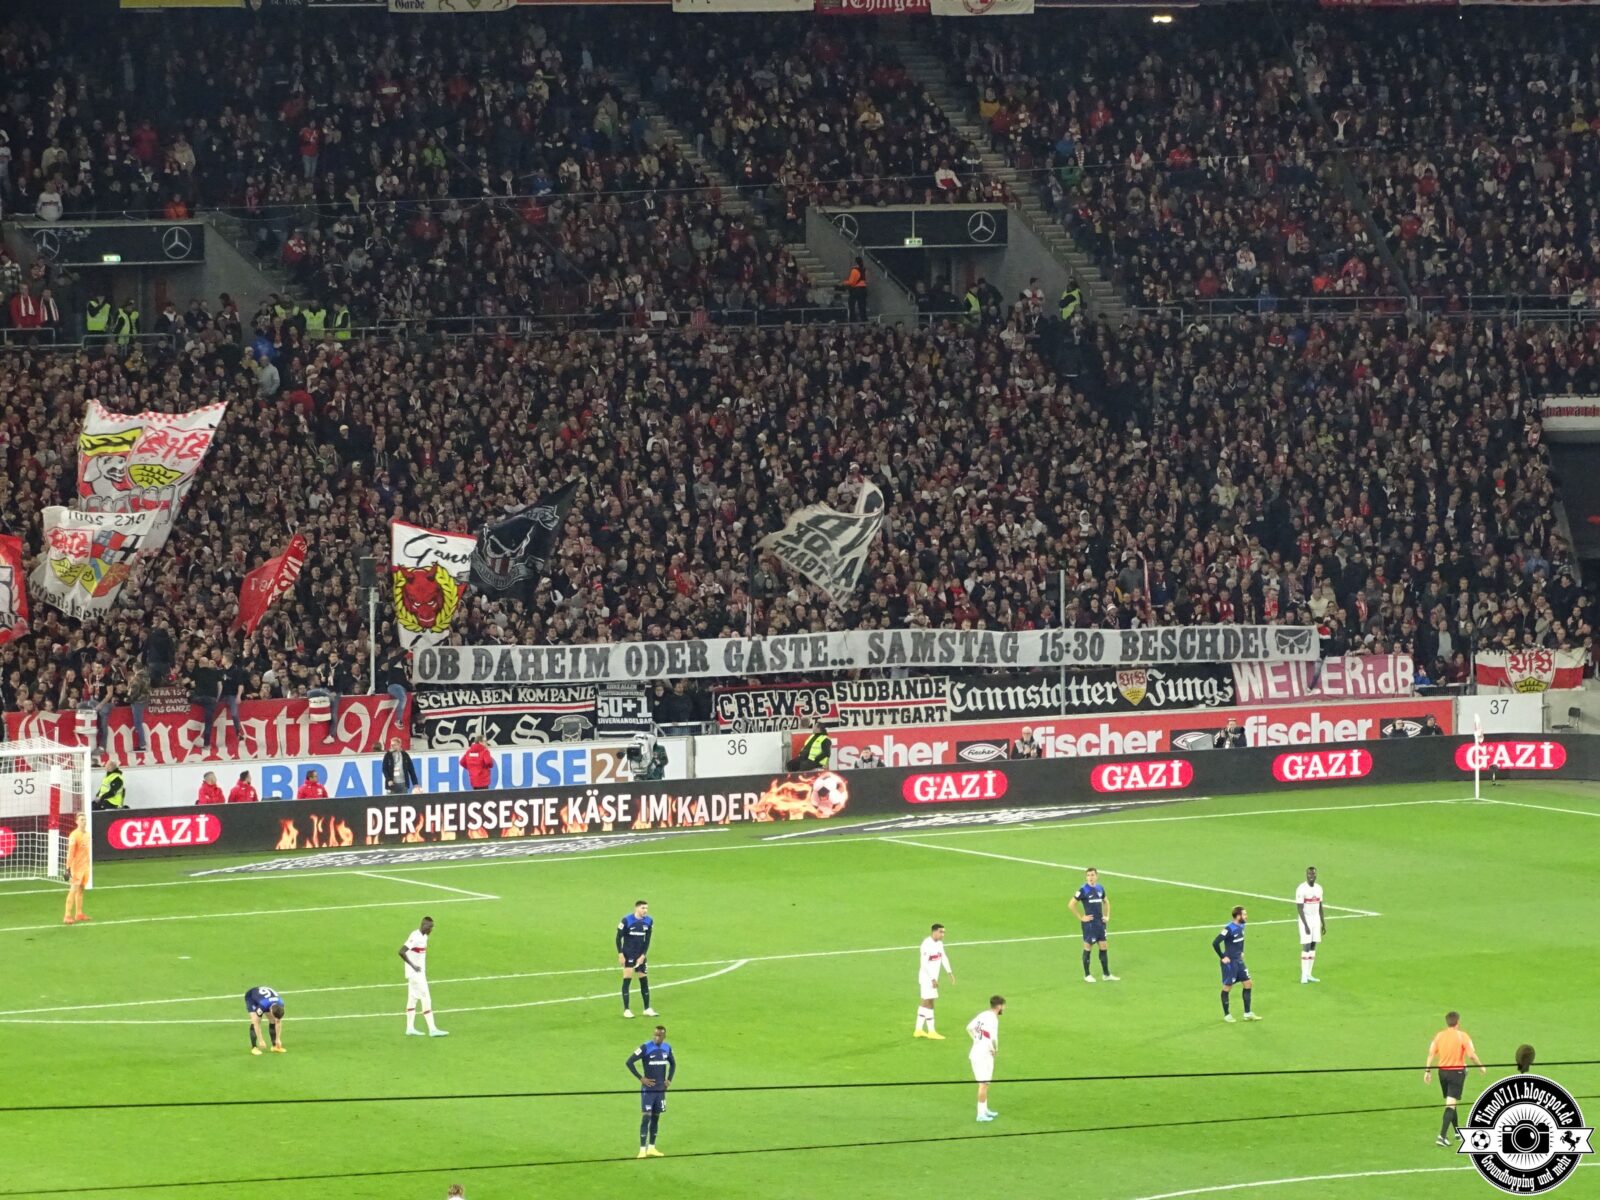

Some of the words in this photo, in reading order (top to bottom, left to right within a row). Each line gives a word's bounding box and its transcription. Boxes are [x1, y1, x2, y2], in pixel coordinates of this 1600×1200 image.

[418, 648, 460, 681] OB
[472, 646, 610, 681] DAHEIM
[625, 641, 710, 677] ODER
[868, 631, 1019, 665] SAMSTAG
[1039, 631, 1105, 663] 15:30
[1120, 627, 1270, 661] BESCHDE!
[417, 688, 513, 709] SCHWABEN
[518, 684, 596, 702] KOMPANIE
[597, 696, 652, 717] 50+1
[950, 674, 1117, 713] Cannstatter
[1490, 699, 1509, 714] 37
[337, 699, 399, 754] 97
[839, 705, 947, 727] STUTTGART
[1245, 712, 1373, 747] fischer
[727, 739, 748, 755] 36
[829, 735, 948, 771] ischer
[1033, 724, 1162, 758] fischer
[14, 778, 35, 795] 35
[367, 806, 416, 836] DER
[425, 798, 559, 832] HEISSESTE
[568, 789, 631, 825] KÄSE
[640, 793, 668, 823] IM
